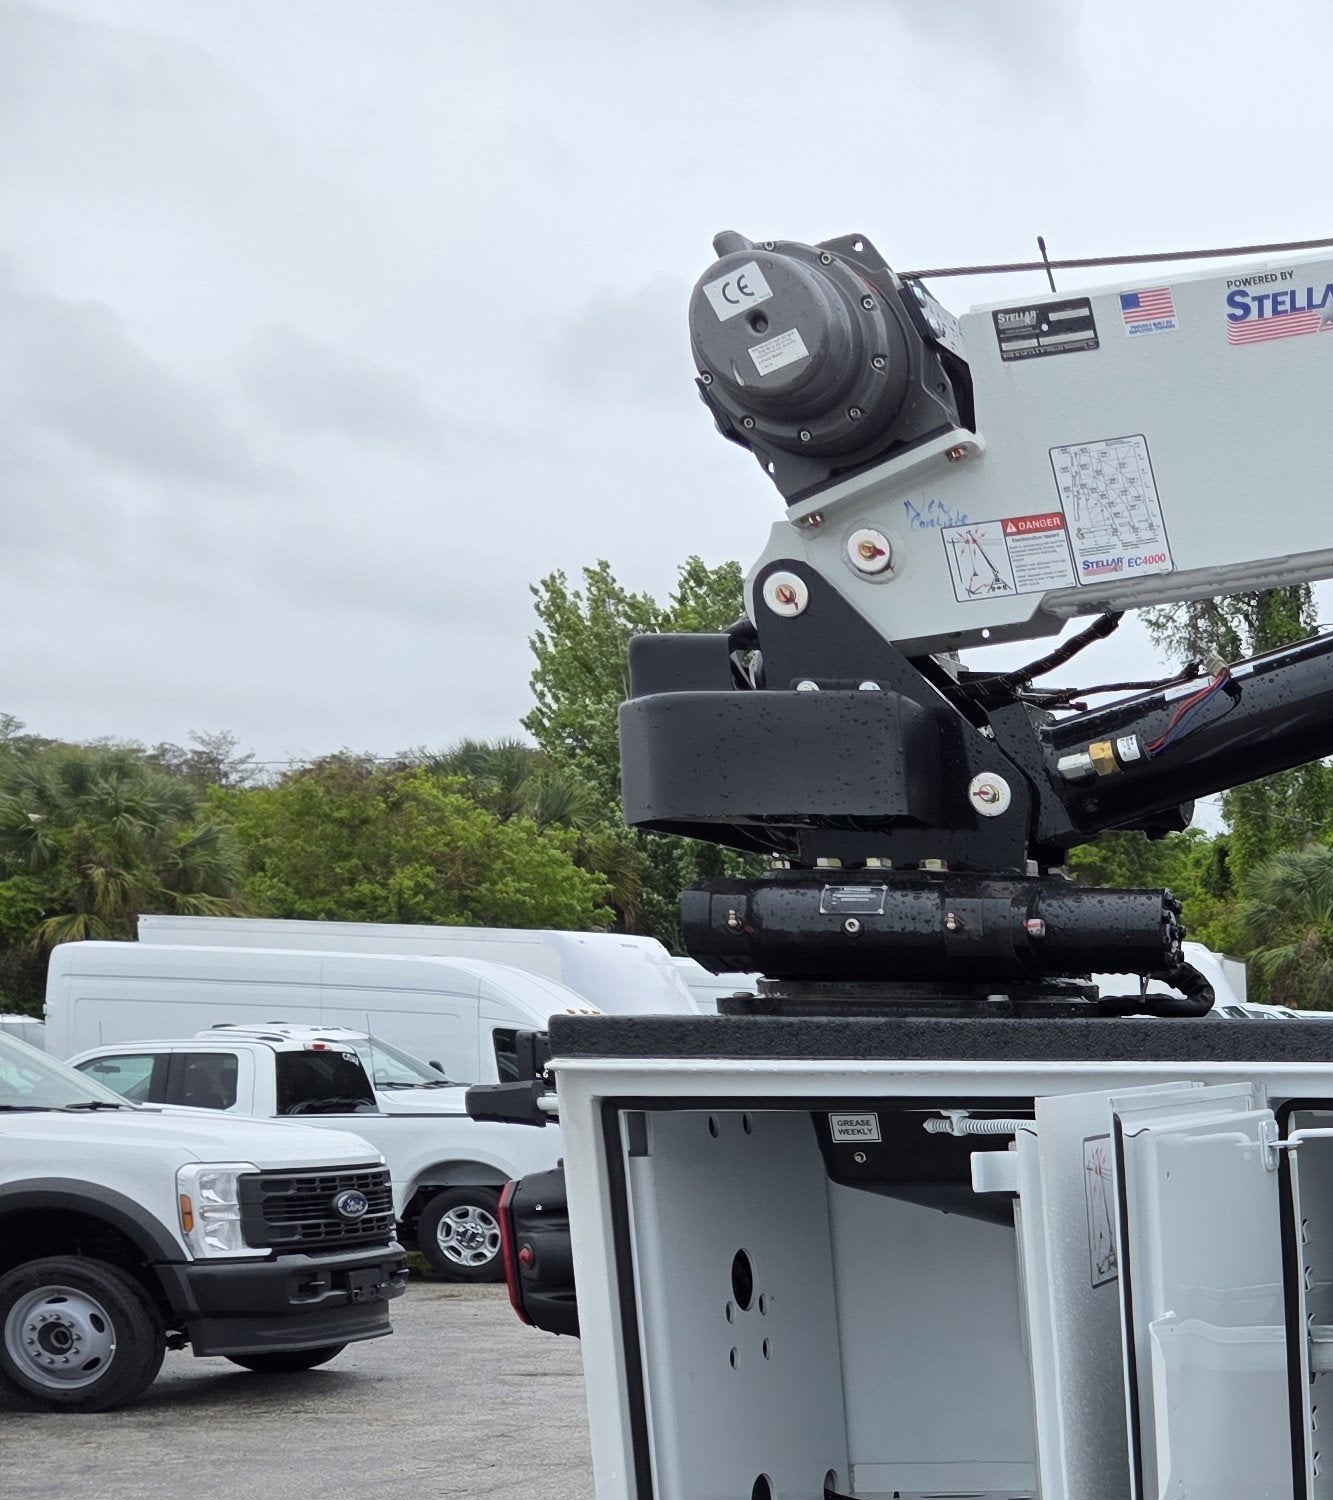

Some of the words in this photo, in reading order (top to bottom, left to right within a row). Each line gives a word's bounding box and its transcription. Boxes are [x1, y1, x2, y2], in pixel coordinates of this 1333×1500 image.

[1226, 273, 1278, 290] POWERED
[1280, 270, 1294, 281] BY
[721, 273, 755, 305] CE
[997, 309, 1037, 325] STELLAR
[1018, 516, 1061, 531] DANGER
[1082, 556, 1124, 571] STELLAR
[1127, 553, 1166, 568] EC4000
[837, 1119, 872, 1127] GREASE
[837, 1128, 873, 1136] WEEKLY
